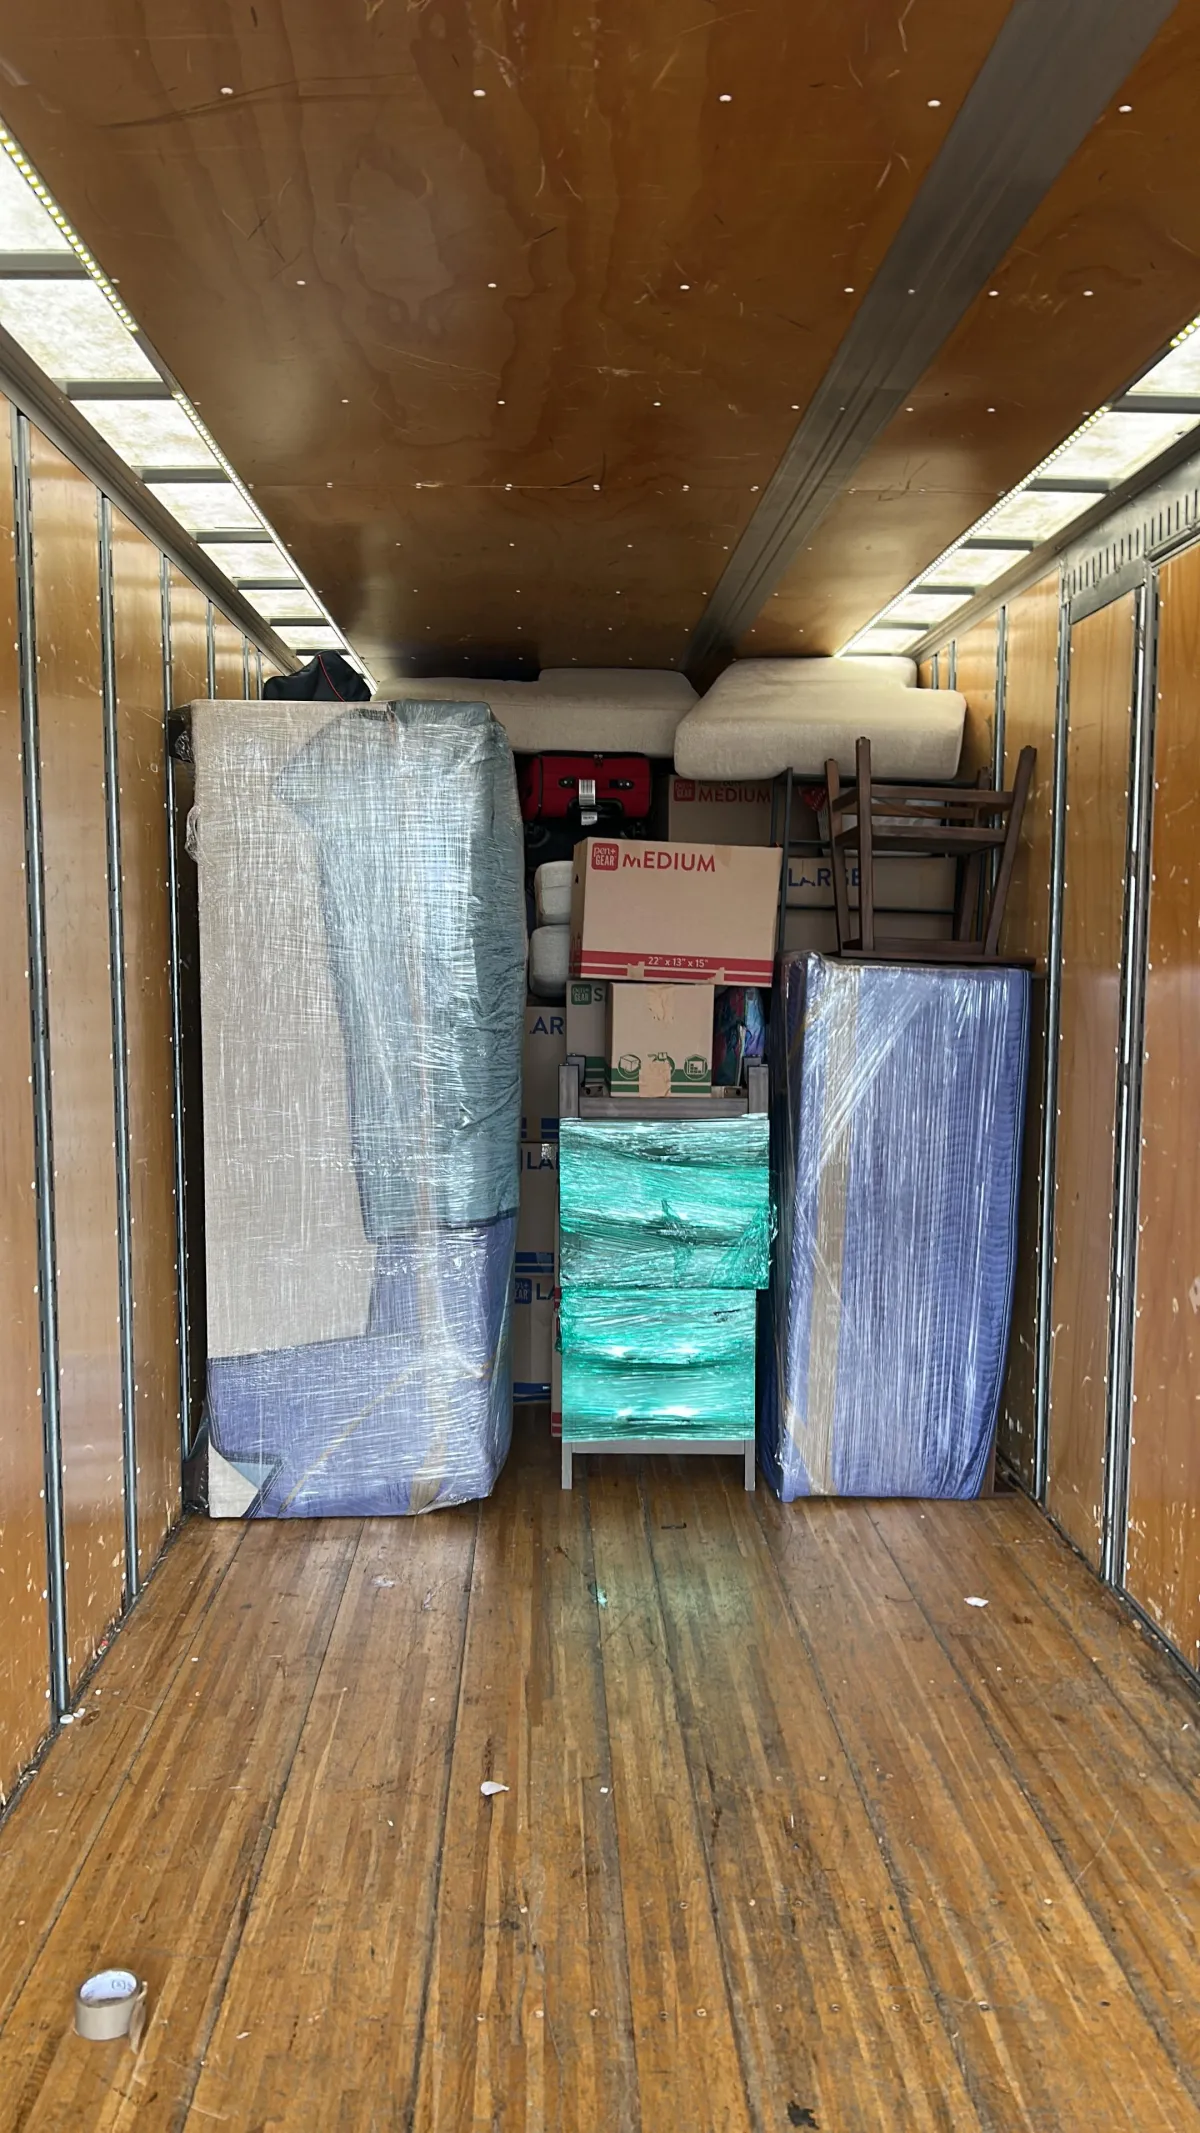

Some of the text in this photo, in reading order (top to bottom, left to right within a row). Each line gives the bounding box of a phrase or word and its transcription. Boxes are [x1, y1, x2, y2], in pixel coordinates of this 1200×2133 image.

[698, 787, 771, 803] MEDIUM
[593, 847, 616, 858] pen+
[595, 855, 615, 866] GEAR
[622, 850, 716, 872] MEDIUM
[574, 993, 589, 1002] GEAR
